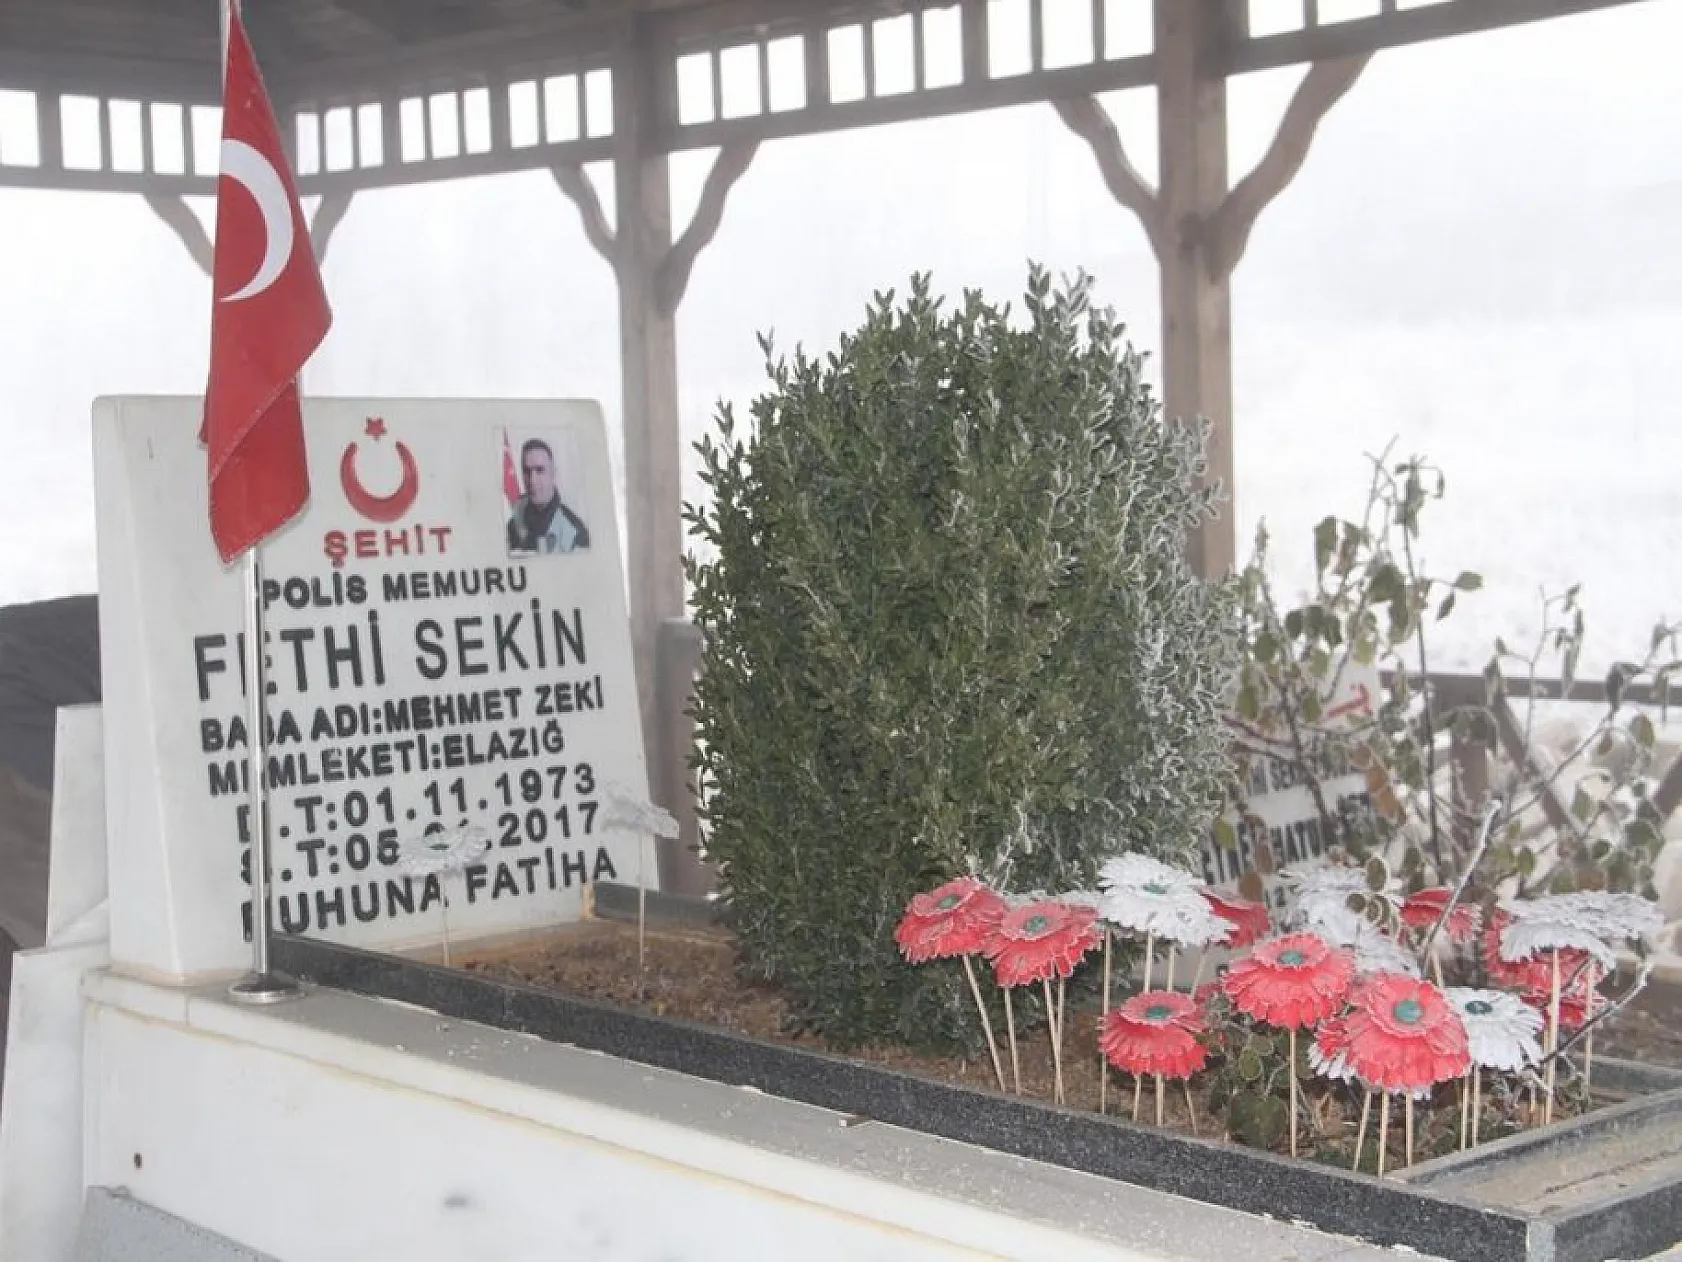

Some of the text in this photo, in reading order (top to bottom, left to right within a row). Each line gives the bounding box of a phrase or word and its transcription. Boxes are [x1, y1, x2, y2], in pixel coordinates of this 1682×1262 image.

[324, 524, 452, 568] ŞEHİT
[262, 566, 527, 610] POLİS MEMURU
[415, 597, 587, 680] SEKİN
[535, 675, 604, 716] ZEKİ
[465, 847, 617, 904] FATİHA
